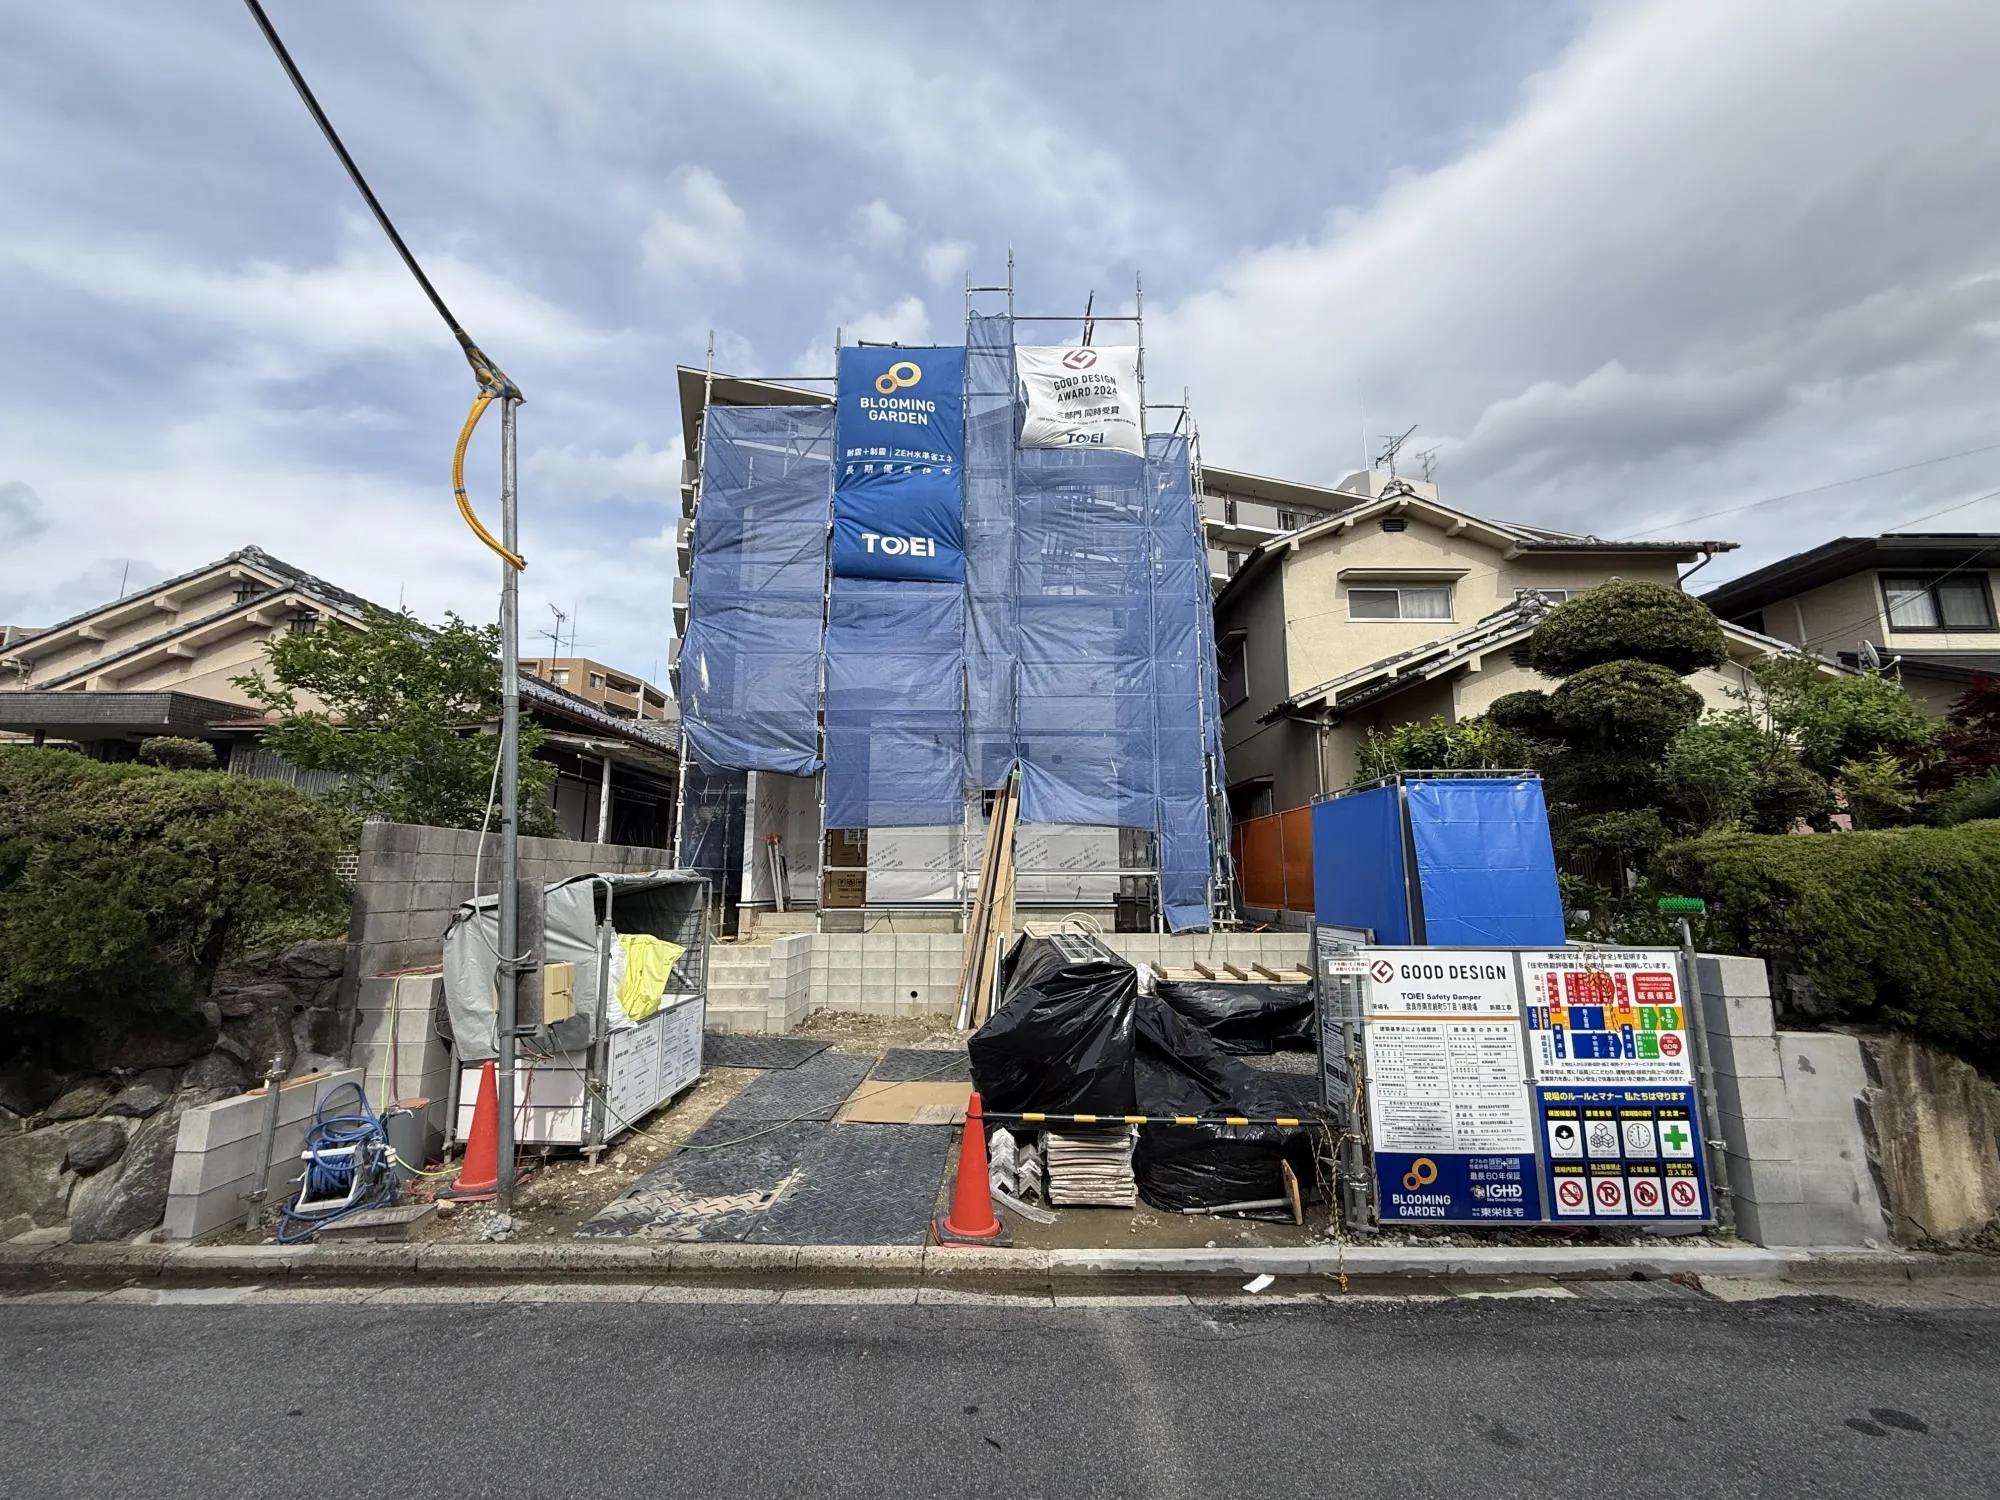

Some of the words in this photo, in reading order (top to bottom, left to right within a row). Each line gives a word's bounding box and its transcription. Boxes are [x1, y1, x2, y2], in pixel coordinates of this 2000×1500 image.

[1053, 376, 1079, 391] GOOD
[1082, 374, 1116, 386] DESIGN
[1057, 387, 1091, 403] AWARD
[860, 397, 936, 413] BLOOMING
[1084, 405, 1120, 418] 同時受賞
[868, 410, 928, 426] GARDEN
[894, 448, 953, 463] ZEH水準省エネ
[1401, 964, 1444, 980] GOOD
[1450, 965, 1507, 980] DESIGN
[1427, 993, 1451, 1002] Safety
[1452, 994, 1482, 1002] Damper
[1637, 992, 1674, 1000] 延長保証
[1543, 1092, 1623, 1101] 現場のルールとマナー
[1624, 1092, 1687, 1101] 私たちは守ります
[1470, 1172, 1521, 1180] 最長60年保証
[1392, 1194, 1451, 1206] BLOOMING
[1399, 1205, 1446, 1217] GARDEN
[1480, 1207, 1525, 1217] 東栄住宅
